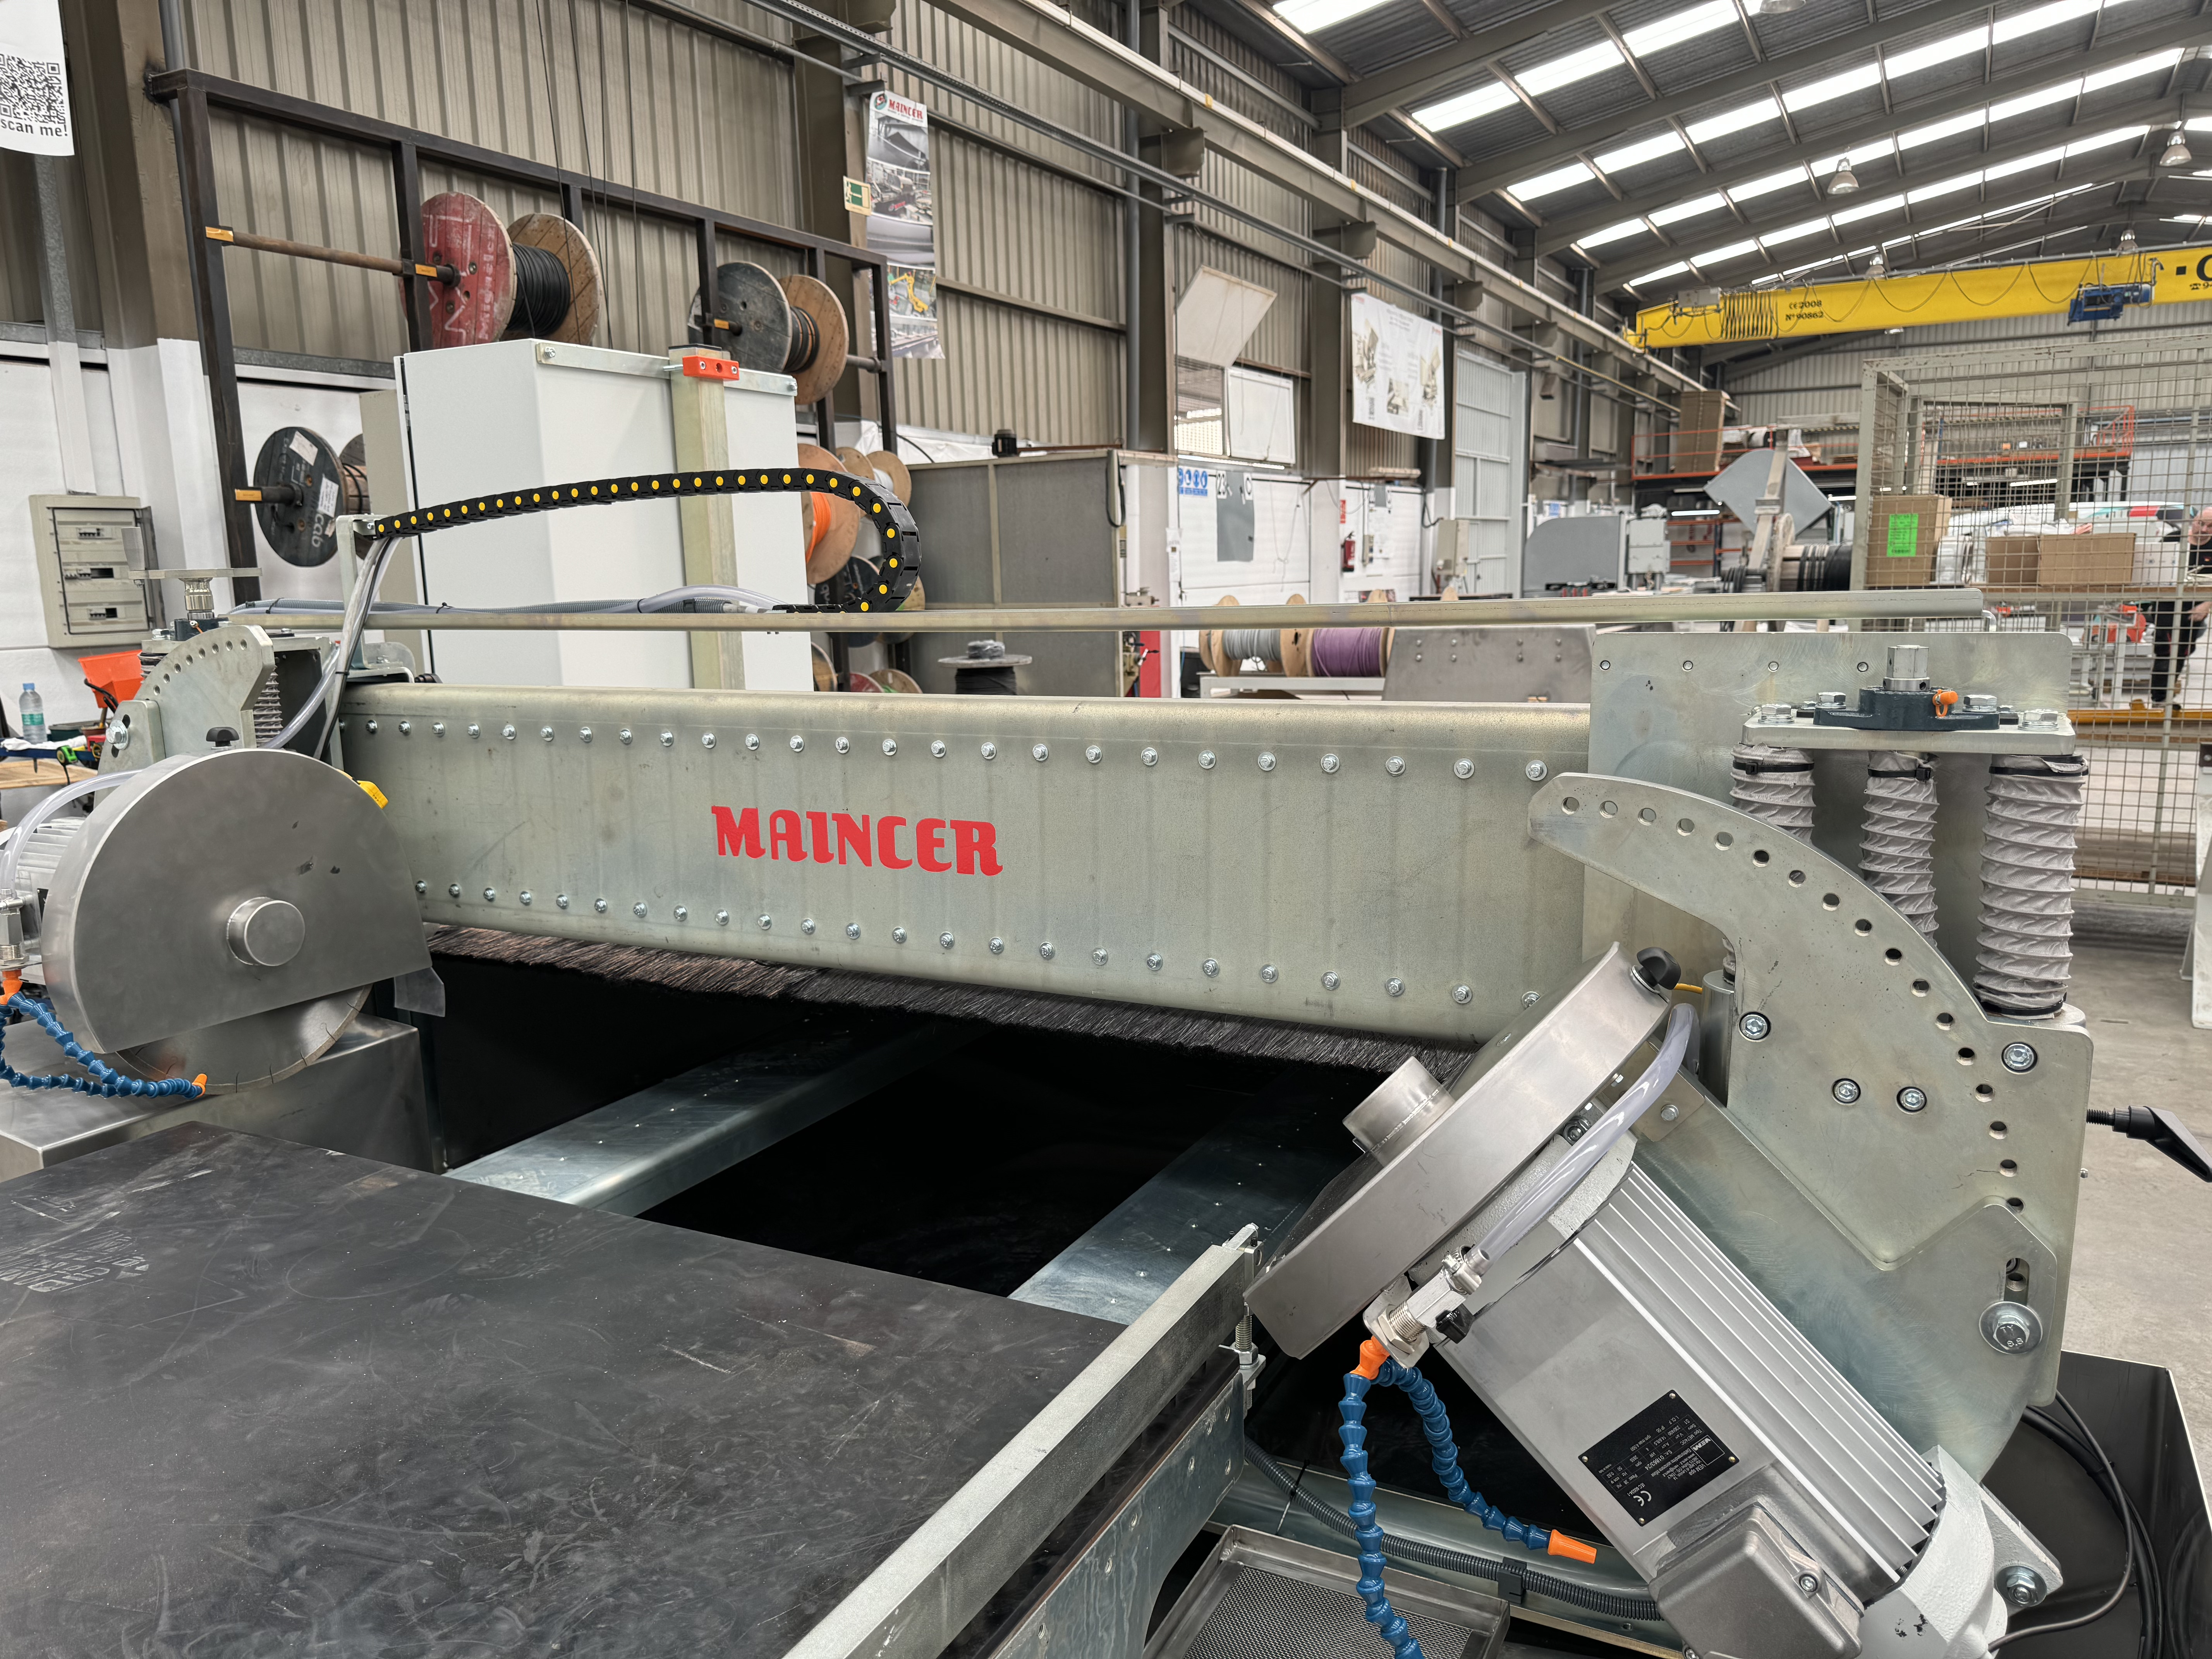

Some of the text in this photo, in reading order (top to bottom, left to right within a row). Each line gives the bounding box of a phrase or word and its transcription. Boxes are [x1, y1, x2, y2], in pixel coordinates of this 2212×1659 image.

[889, 99, 924, 120] MAINCER
[0, 118, 68, 137] scan me!
[711, 805, 1004, 877] MAINCER
[1692, 1438, 1711, 1451] VEM
[1645, 1455, 1664, 1470] 01863/24
[1695, 1463, 1706, 1472] VEM
[1667, 1471, 1676, 1479] ITALY
